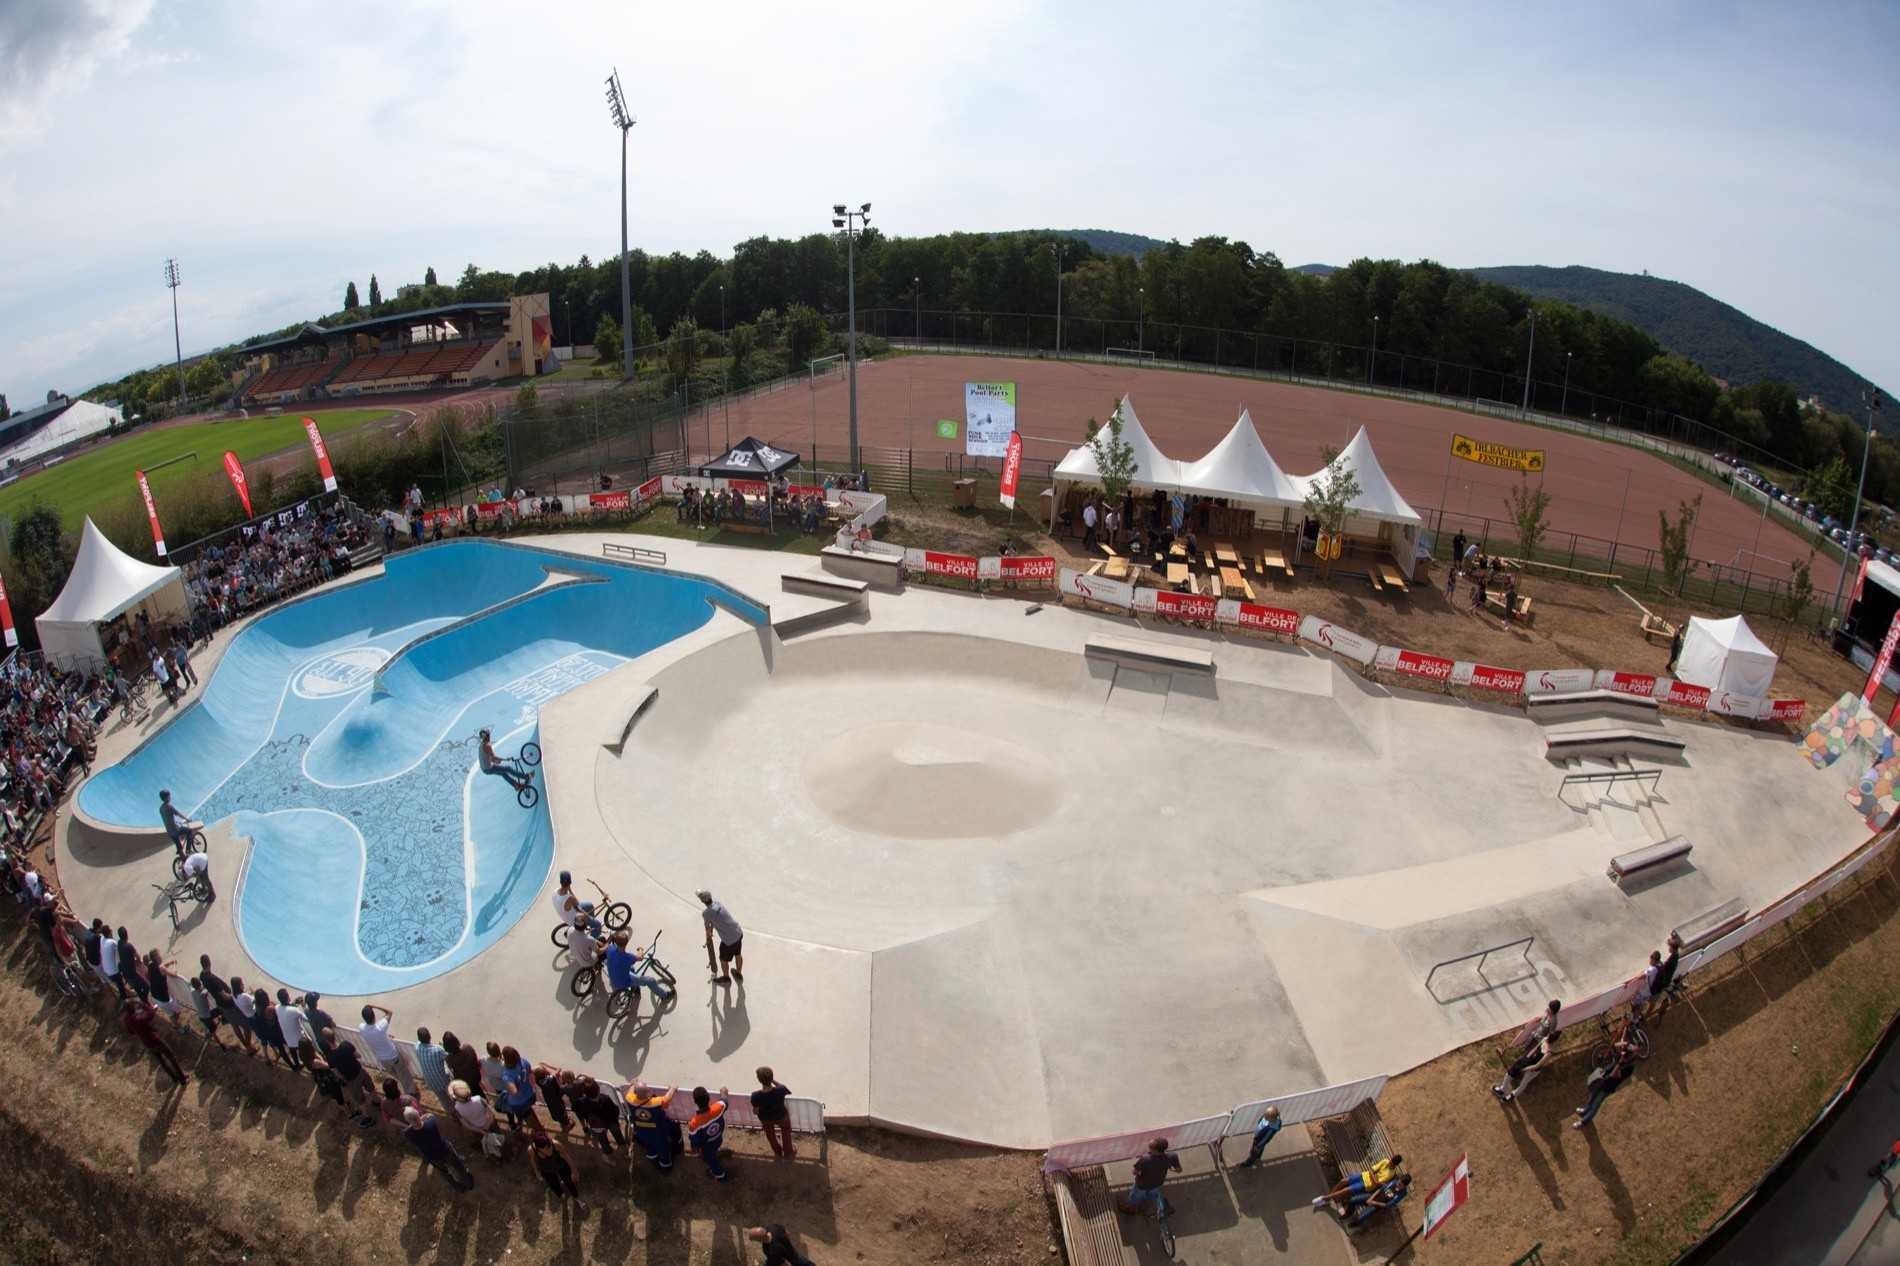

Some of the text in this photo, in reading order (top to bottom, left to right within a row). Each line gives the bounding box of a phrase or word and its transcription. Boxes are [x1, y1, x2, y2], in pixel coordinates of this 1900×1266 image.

[726, 449, 753, 467] DC
[757, 446, 781, 463] DC
[1474, 443, 1527, 460] IRLBACHER
[926, 561, 976, 576] BELFORT
[946, 559, 965, 567] VILLE
[1001, 566, 1053, 576] BELFORT
[1157, 601, 1214, 616] BELFORT
[1181, 599, 1202, 607] VILLE
[1239, 613, 1296, 629] BELFORT
[1264, 610, 1284, 619] VILLE
[1397, 660, 1450, 677] BELFORT
[1421, 659, 1439, 667] VILLE
[1471, 675, 1522, 689] BELFORT
[1494, 672, 1512, 680] VILLE
[1612, 681, 1652, 694] BELFORT
[1687, 688, 1701, 696] VILLE
[1669, 690, 1708, 706] BELFORT
[1772, 709, 1802, 717] BELFORT
